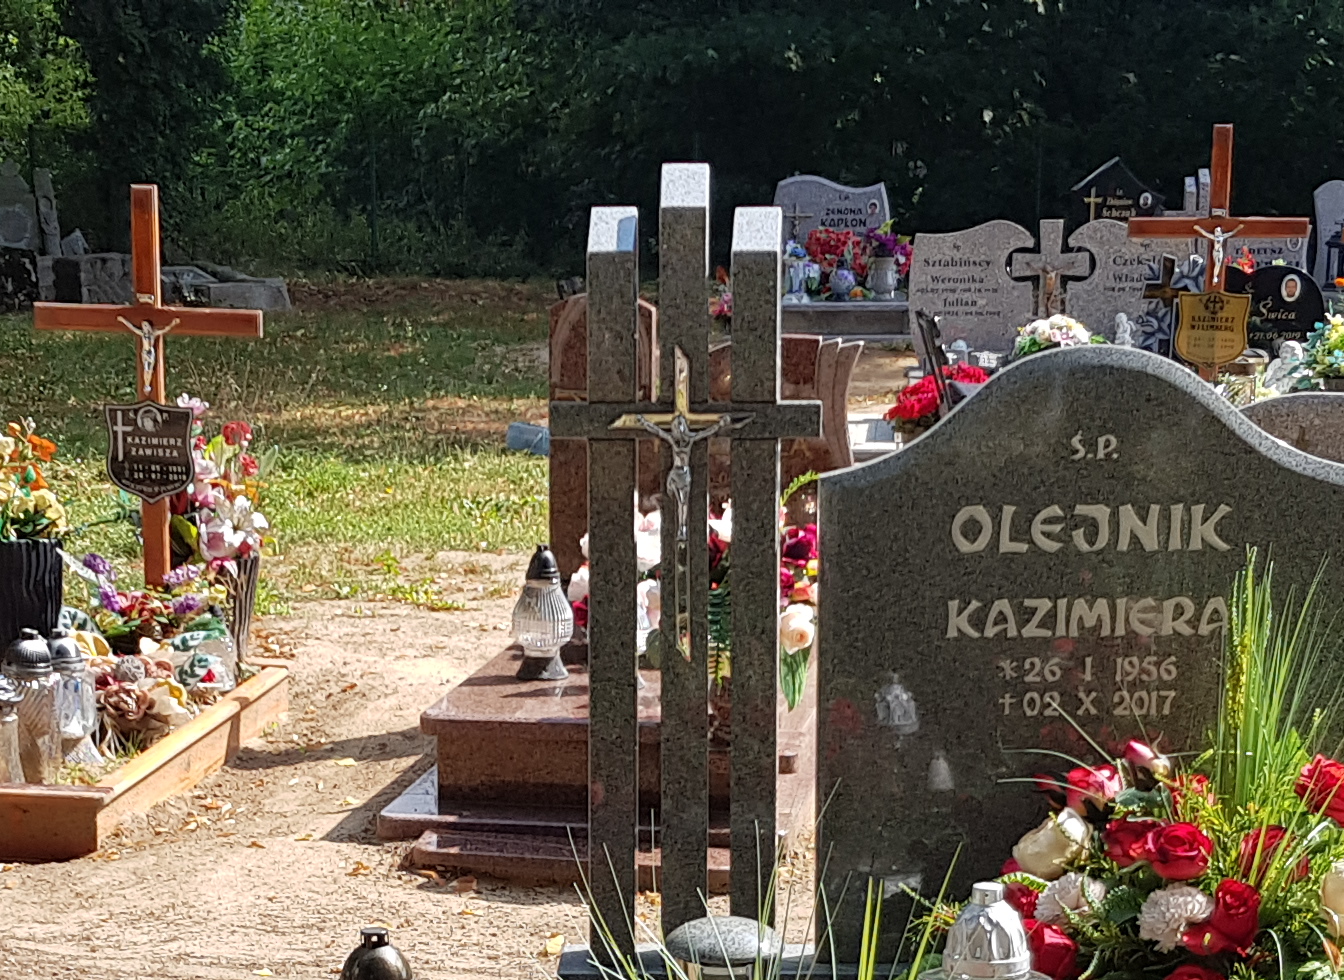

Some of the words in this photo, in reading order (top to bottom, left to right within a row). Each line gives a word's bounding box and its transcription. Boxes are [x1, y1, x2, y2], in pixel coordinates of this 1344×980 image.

[126, 436, 183, 447] KAZIMIERZ
[130, 447, 179, 458] ZAWISZA
[951, 502, 1233, 554] OLEJNIK
[945, 596, 1230, 639] KAZIMIERA
[1115, 655, 1178, 683] 1956
[1076, 686, 1098, 716] X
[1112, 689, 1177, 717] 2017
